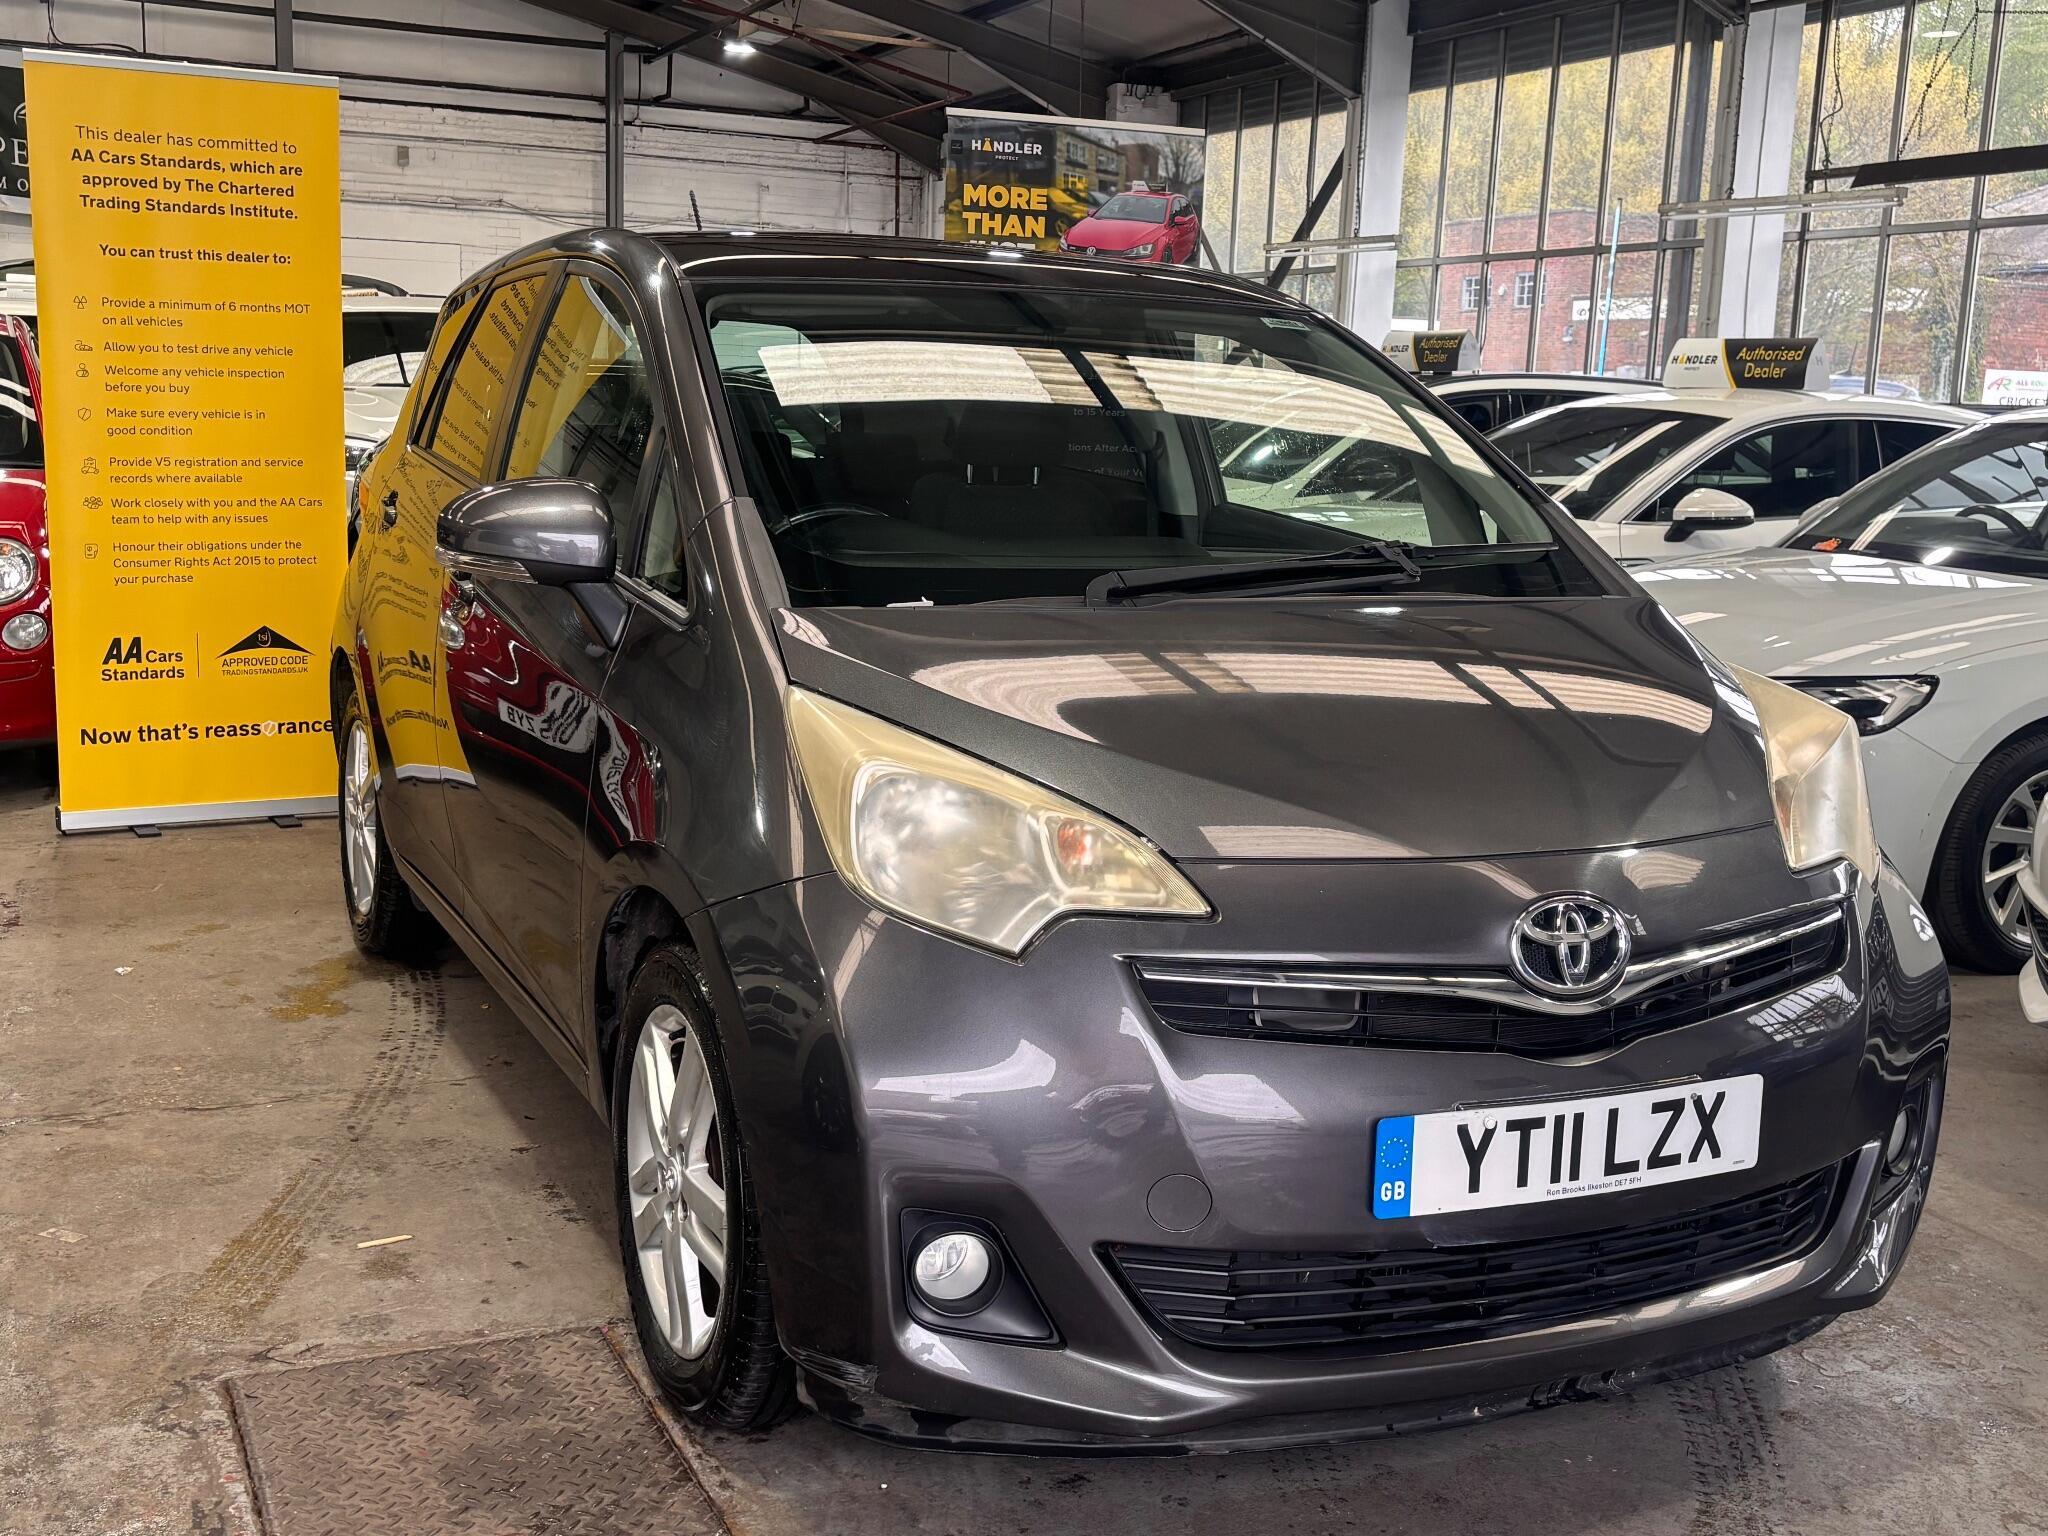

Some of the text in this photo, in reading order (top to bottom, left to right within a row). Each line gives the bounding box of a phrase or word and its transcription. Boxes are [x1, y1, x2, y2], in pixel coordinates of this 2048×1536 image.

[75, 125, 297, 154] This dealer has committed to
[71, 149, 303, 176] AA Cars Standards, which are
[82, 174, 294, 197] approved by The Chartered
[963, 184, 1047, 210] MORE
[80, 195, 298, 219] Trading Standards Institute.
[962, 211, 1046, 238] THAN
[100, 244, 291, 264] You can trust this dealer to:
[102, 297, 310, 314] Provide a minimum of 6 months MOT
[102, 315, 183, 327] on all vehicles
[104, 342, 293, 356] Allow you to test drive any vehicle
[1419, 336, 1461, 348] Authorised
[1423, 351, 1448, 362] Dealer
[1736, 346, 1806, 360] Authorised
[105, 365, 285, 379] Welcome any vehicle inspection
[1744, 363, 1787, 378] Dealer
[105, 382, 189, 394] before you buy
[107, 408, 265, 420] Make sure every vehicle is in
[1074, 408, 1126, 417] to 15 Years
[107, 426, 193, 436] good condition
[109, 457, 304, 468] Provide V5 registration and service
[110, 474, 243, 483] records where available
[111, 498, 323, 510] Work closely with you and the AA Cars
[112, 514, 268, 525] team to help with any issues
[113, 540, 302, 552] Honour their obligations under the
[113, 556, 317, 568] Consumer Rights Act 2015 to protect
[114, 574, 193, 586] your purchase
[102, 636, 183, 665] AA Cars
[222, 655, 308, 668] APPROVED CODE
[102, 666, 185, 682] Standards
[81, 728, 131, 745] Now
[138, 723, 199, 743] that's
[1456, 1090, 1726, 1194] YT11 LZX
[1380, 1180, 1405, 1202] GB
[1547, 1176, 1642, 1197] Ron Brooks Ilkeston DE7 5FH
